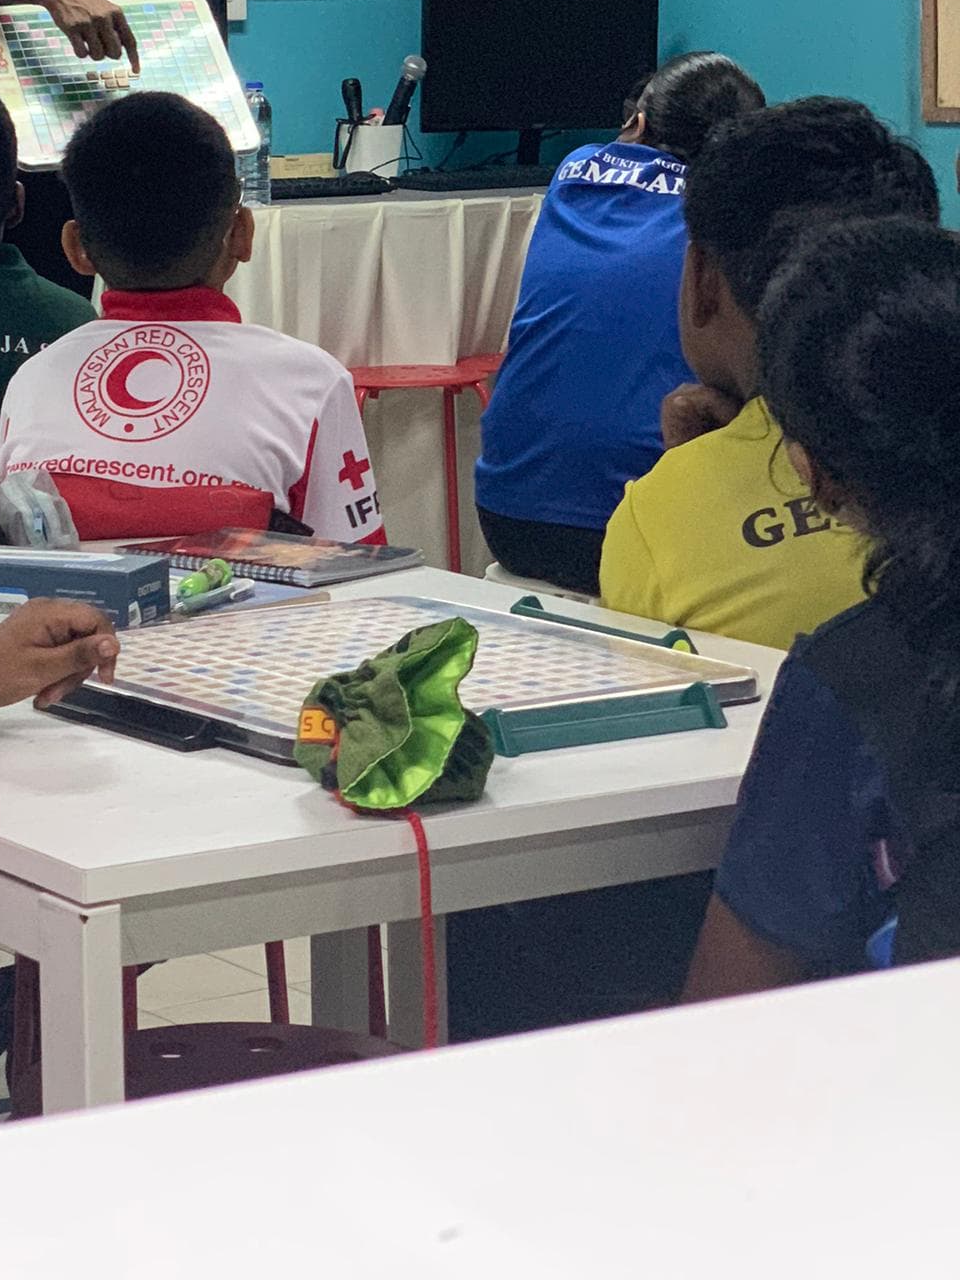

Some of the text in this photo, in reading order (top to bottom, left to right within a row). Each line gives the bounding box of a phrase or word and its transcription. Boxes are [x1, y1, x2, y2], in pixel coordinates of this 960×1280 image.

[80, 330, 204, 434] MALAYSIAN RED CRESCENT
[741, 495, 852, 548] GE
